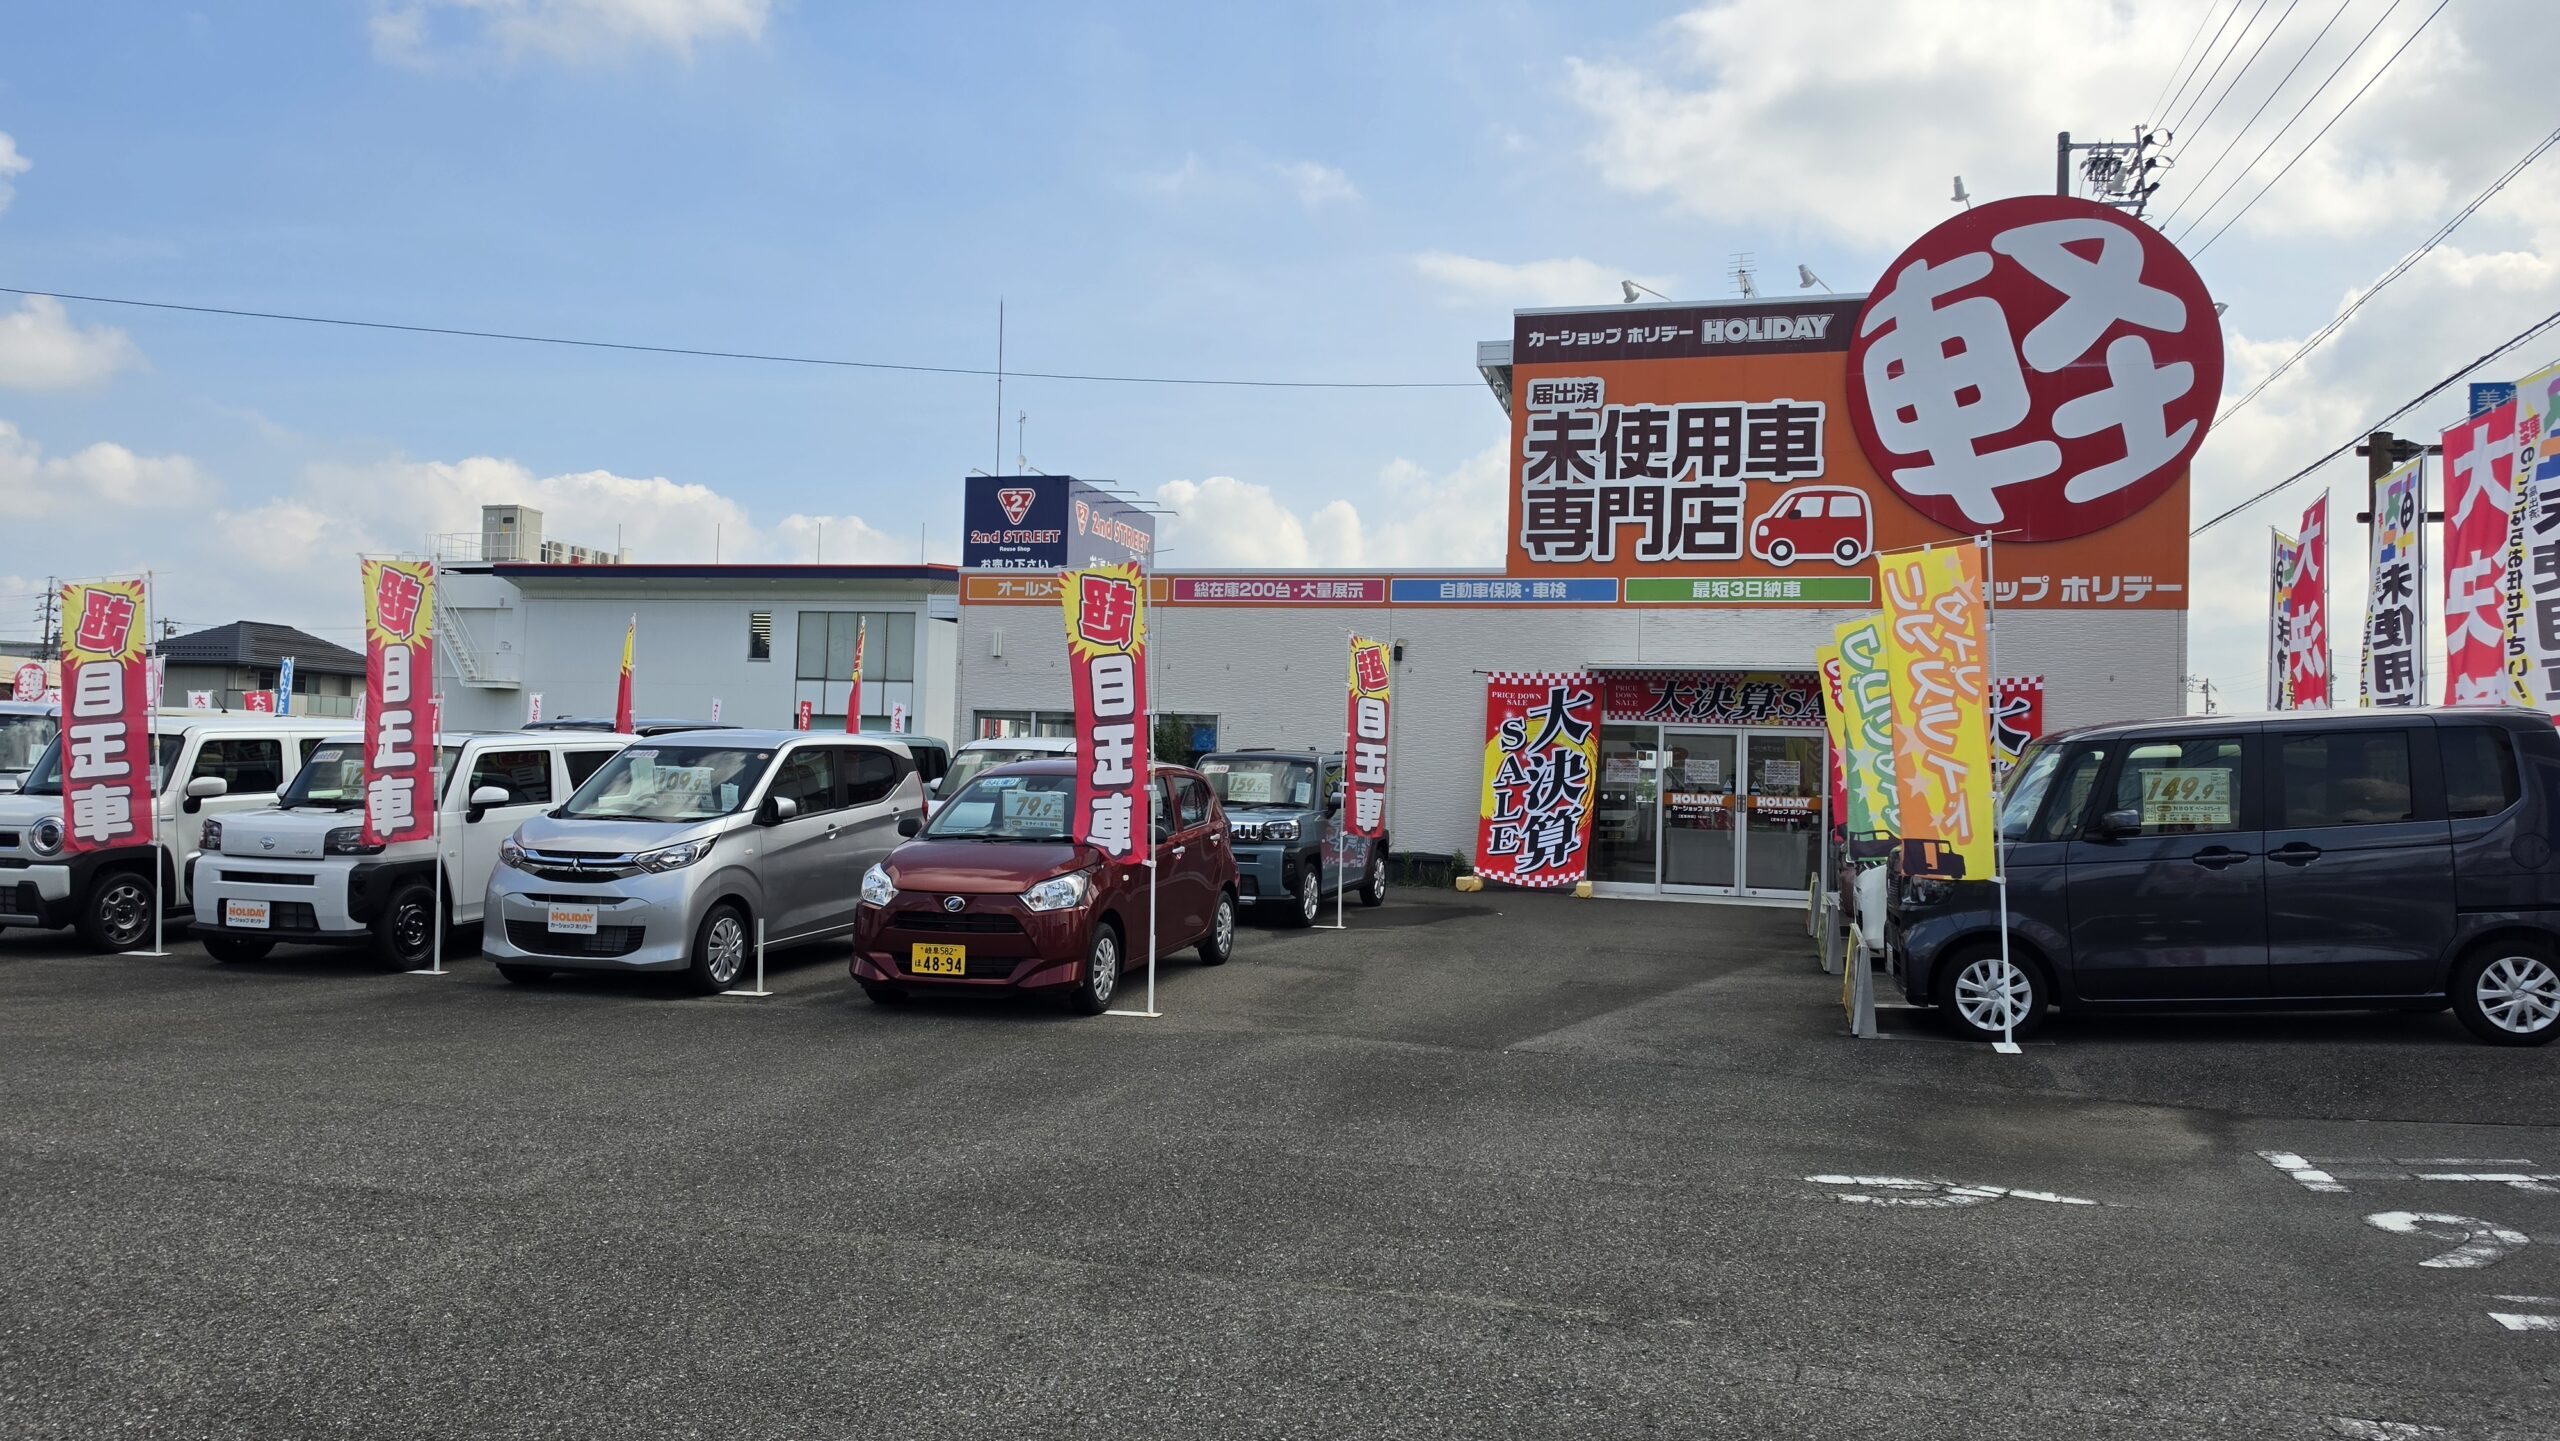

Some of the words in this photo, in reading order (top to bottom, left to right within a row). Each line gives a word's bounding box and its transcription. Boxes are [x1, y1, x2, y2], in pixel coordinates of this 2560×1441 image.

[1527, 328, 1622, 347] カーショップ
[1626, 325, 1694, 344] ホリデー
[1702, 314, 1834, 345] HOLIDAY
[1861, 217, 2197, 525] 軽
[1530, 382, 1601, 406] 届出済
[1525, 402, 1824, 483] 未使用車
[1091, 511, 1113, 541] 2nd
[1113, 520, 1151, 554] STREET
[1523, 482, 1743, 561] 専門店
[970, 530, 1000, 544] 2nd
[1003, 529, 1061, 544] STREET
[1193, 581, 1364, 600] 総在庫200台・大量展示
[1439, 581, 1567, 600] 自動車保険・車検
[1692, 580, 1801, 600] 最短3日納車
[2060, 575, 2183, 602] ホリデー
[1491, 691, 1516, 699] PRICE
[1517, 692, 1542, 700] DOWN
[1354, 645, 1389, 832] 超目玉車
[1487, 717, 1527, 856] SALE
[1514, 686, 1594, 874] 大決算
[2147, 776, 2215, 801] 149.9
[1016, 796, 1053, 817] 79.9
[1672, 793, 1724, 805] HOLIDAY
[1757, 796, 1811, 808] HOLIDAY
[229, 907, 266, 918] HOLIDAY
[551, 912, 594, 923] HOLIDAY
[923, 956, 962, 972] 48-94
